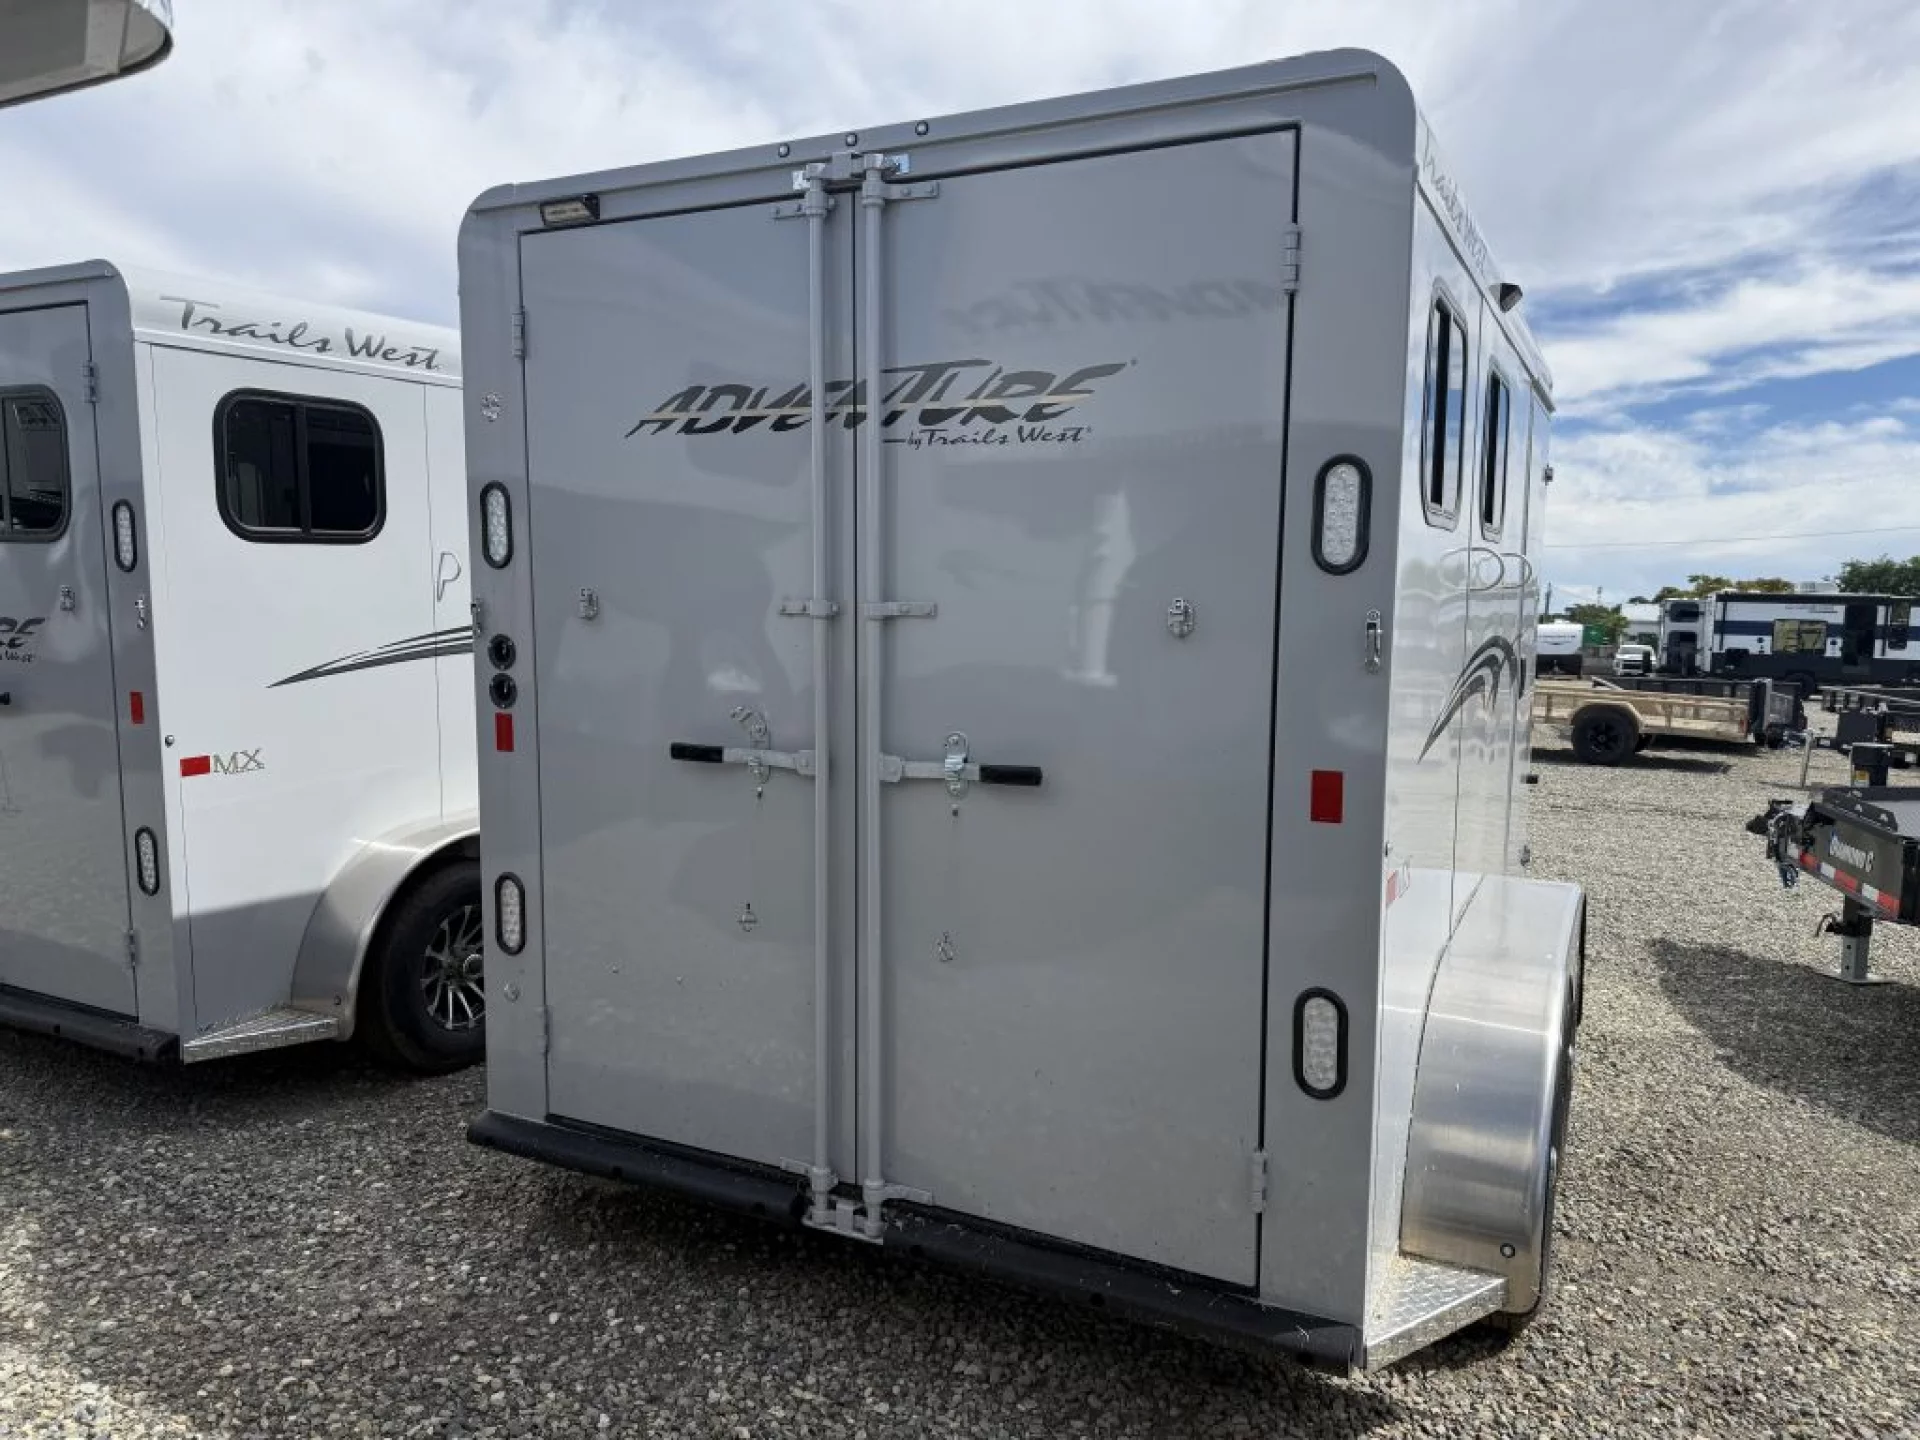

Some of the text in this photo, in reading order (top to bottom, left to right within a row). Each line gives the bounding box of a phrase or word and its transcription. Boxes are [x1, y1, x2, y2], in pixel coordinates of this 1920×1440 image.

[160, 295, 440, 370] Trails West
[920, 427, 1010, 446] Trails
[1017, 425, 1085, 444] West
[213, 747, 265, 775] MX
